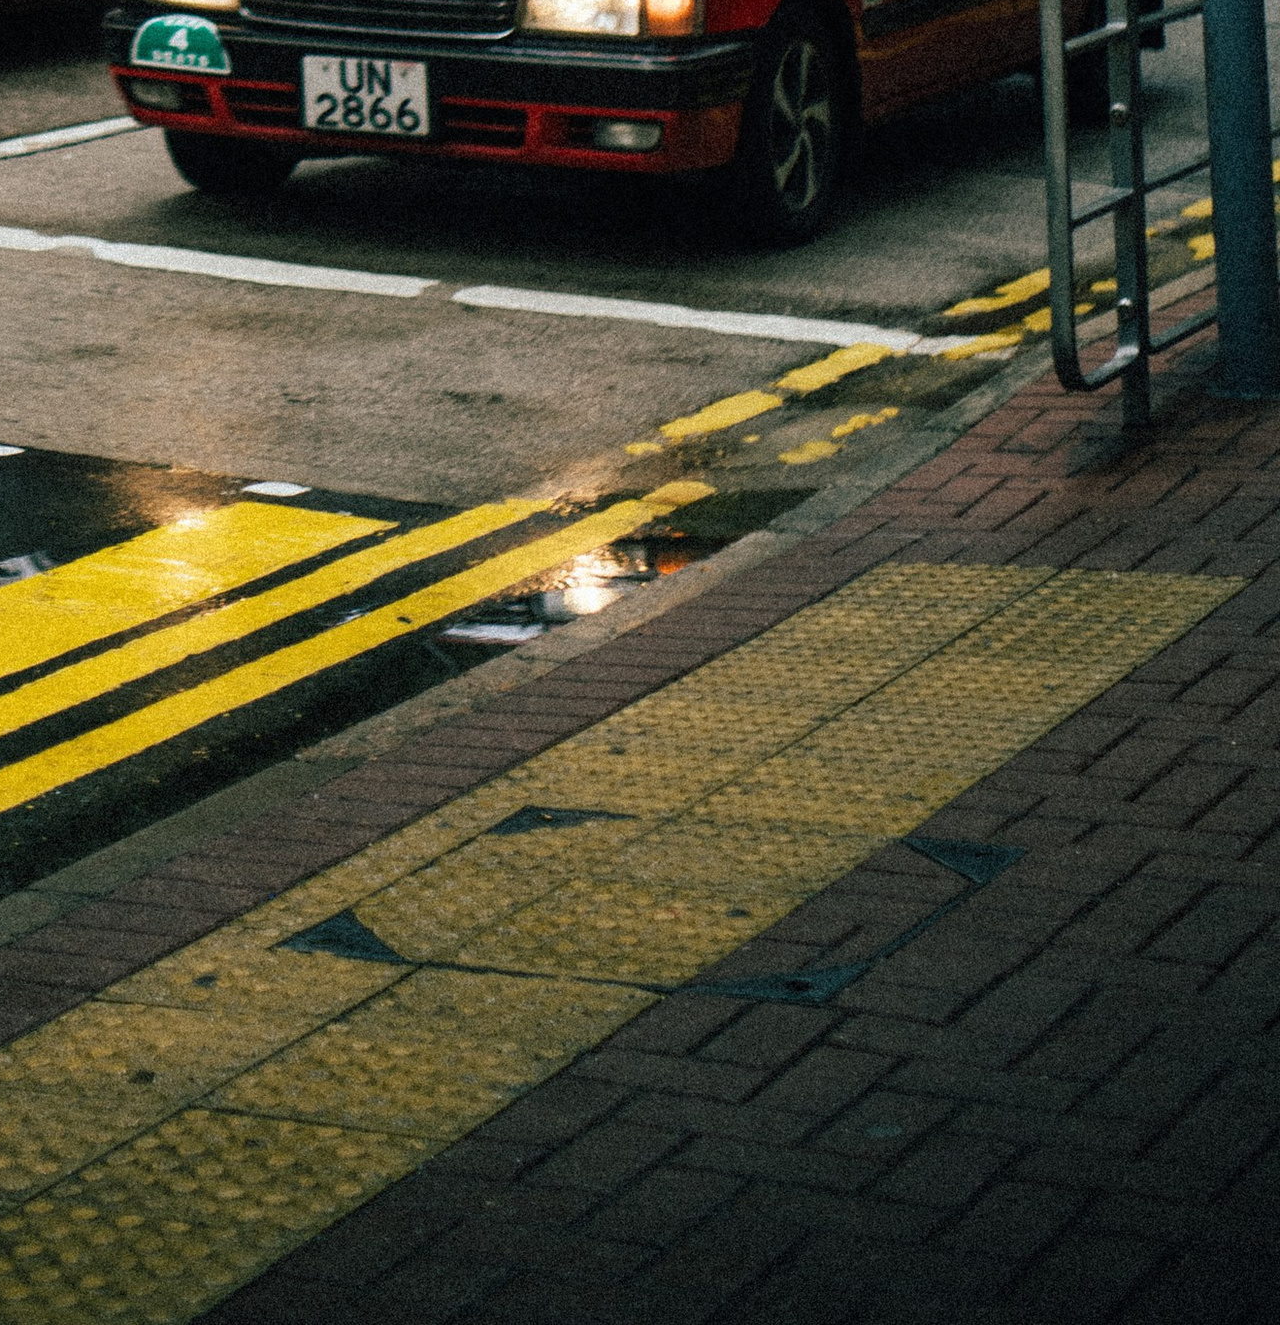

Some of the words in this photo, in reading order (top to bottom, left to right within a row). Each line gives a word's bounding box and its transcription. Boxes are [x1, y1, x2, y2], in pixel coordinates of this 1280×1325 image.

[169, 29, 189, 50] 4
[339, 61, 391, 95] UN
[315, 93, 420, 132] 2866
